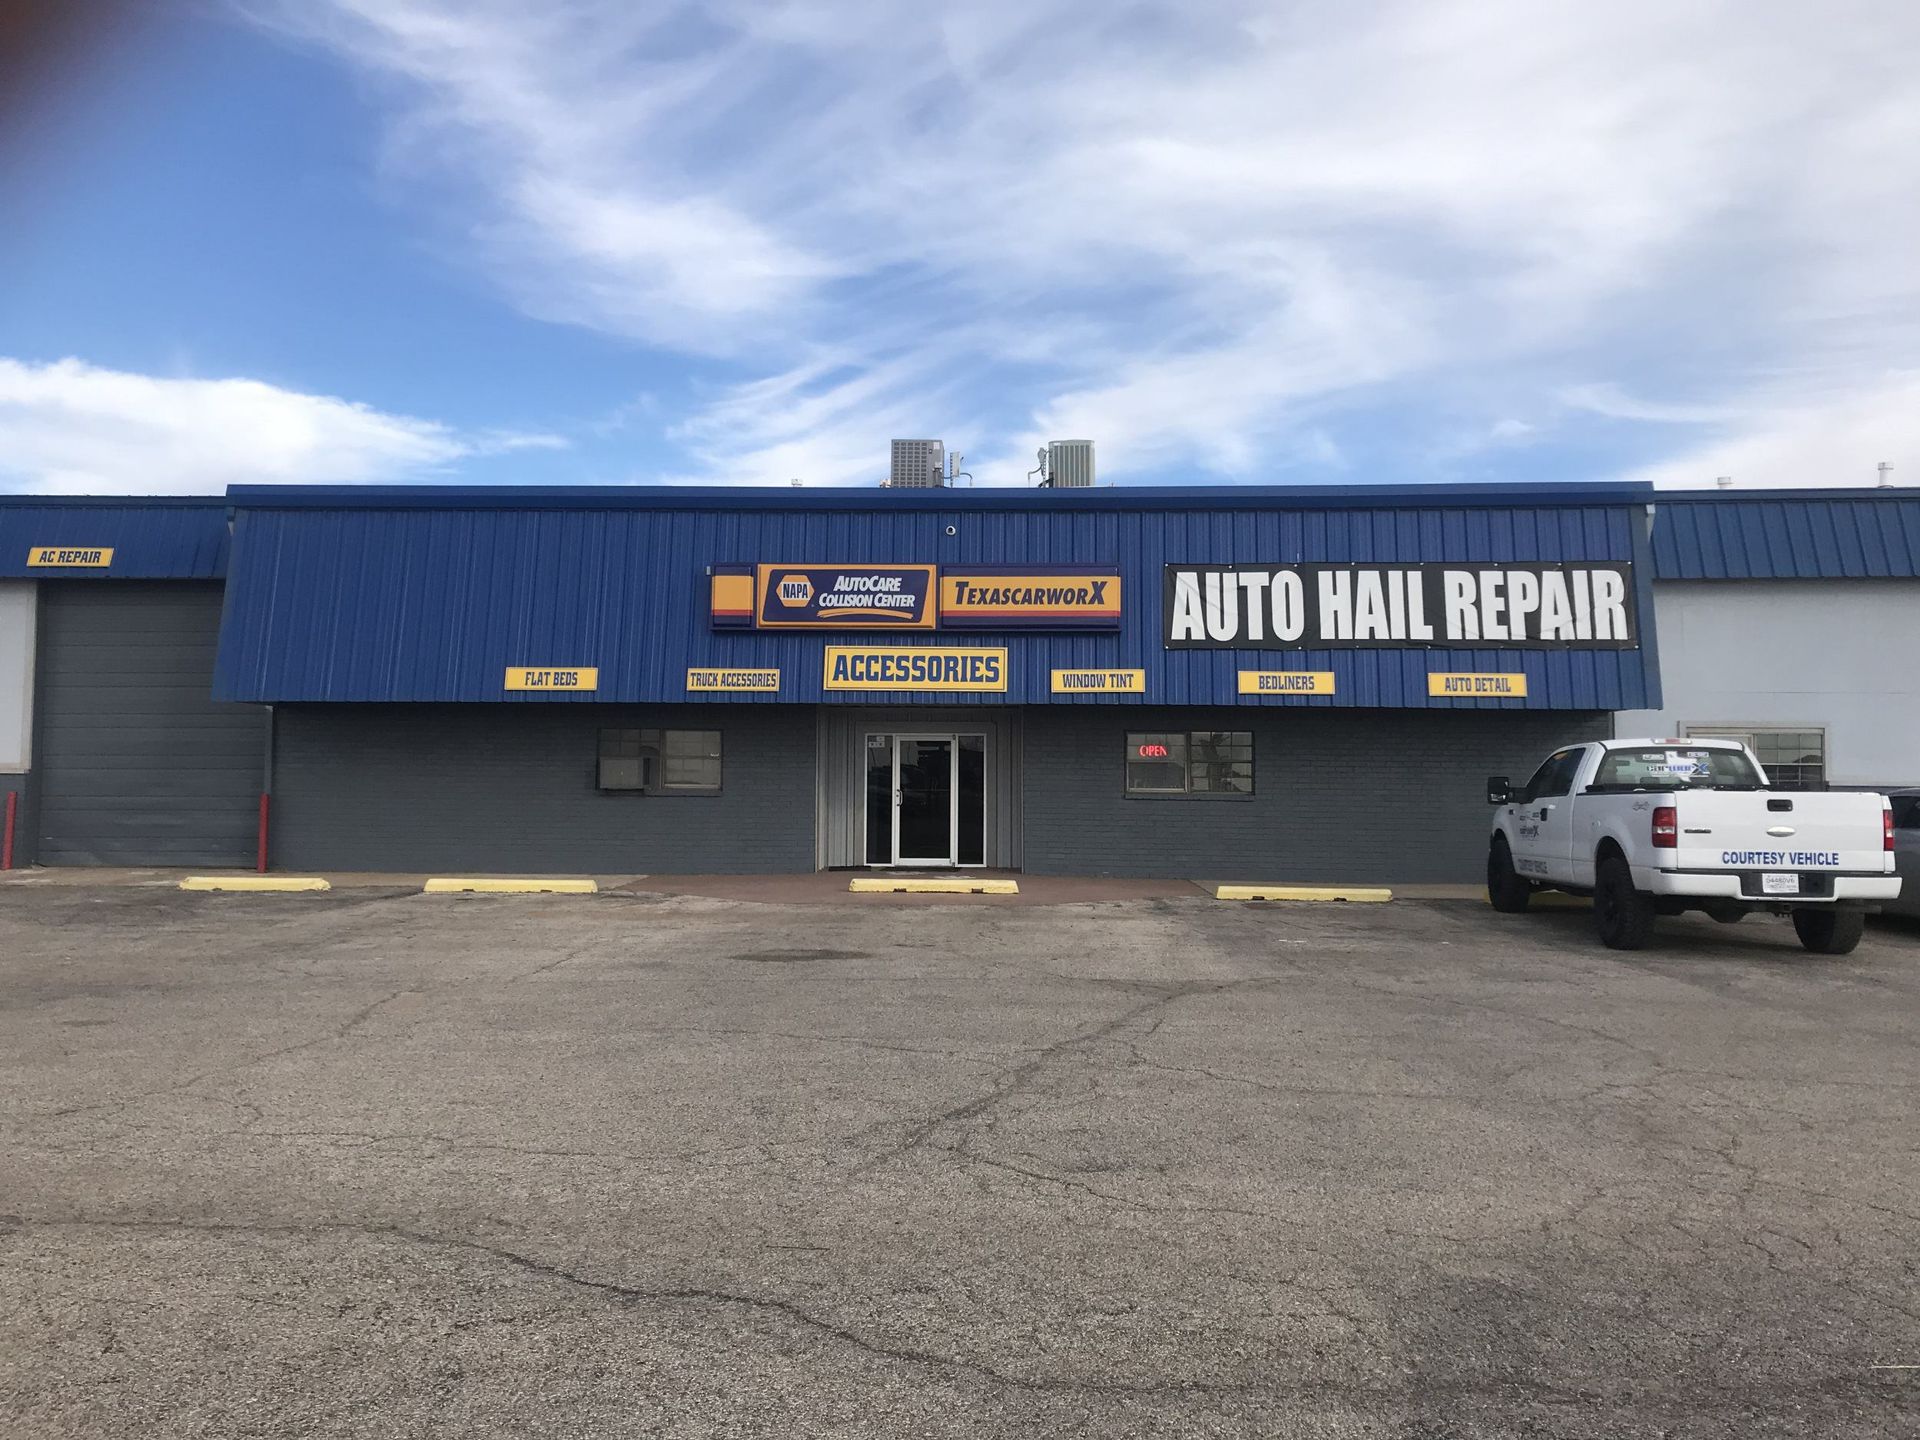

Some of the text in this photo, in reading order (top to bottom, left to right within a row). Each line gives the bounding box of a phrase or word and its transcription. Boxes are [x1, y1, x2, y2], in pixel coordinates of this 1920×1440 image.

[39, 551, 102, 563] AC REPAIR
[782, 581, 809, 600] NAPA
[833, 575, 902, 592] AUTOCARE
[818, 593, 916, 607] COLLISION CENTER
[955, 581, 1108, 605] TEXASCARWORX
[1170, 569, 1629, 643] AUTO HAIL REPAIR
[832, 653, 1001, 683] ACCESSORIES
[525, 671, 578, 686] FLAT BEDS
[690, 672, 777, 687] TRUCK ACCESSORIES
[1062, 673, 1134, 689] WINDOW TINT
[1258, 674, 1315, 691] BEDLINERS
[1444, 677, 1511, 693] AUTO DETAIL
[1139, 745, 1168, 757] OPEN
[1722, 851, 1840, 866] COURTESY VEHICLE
